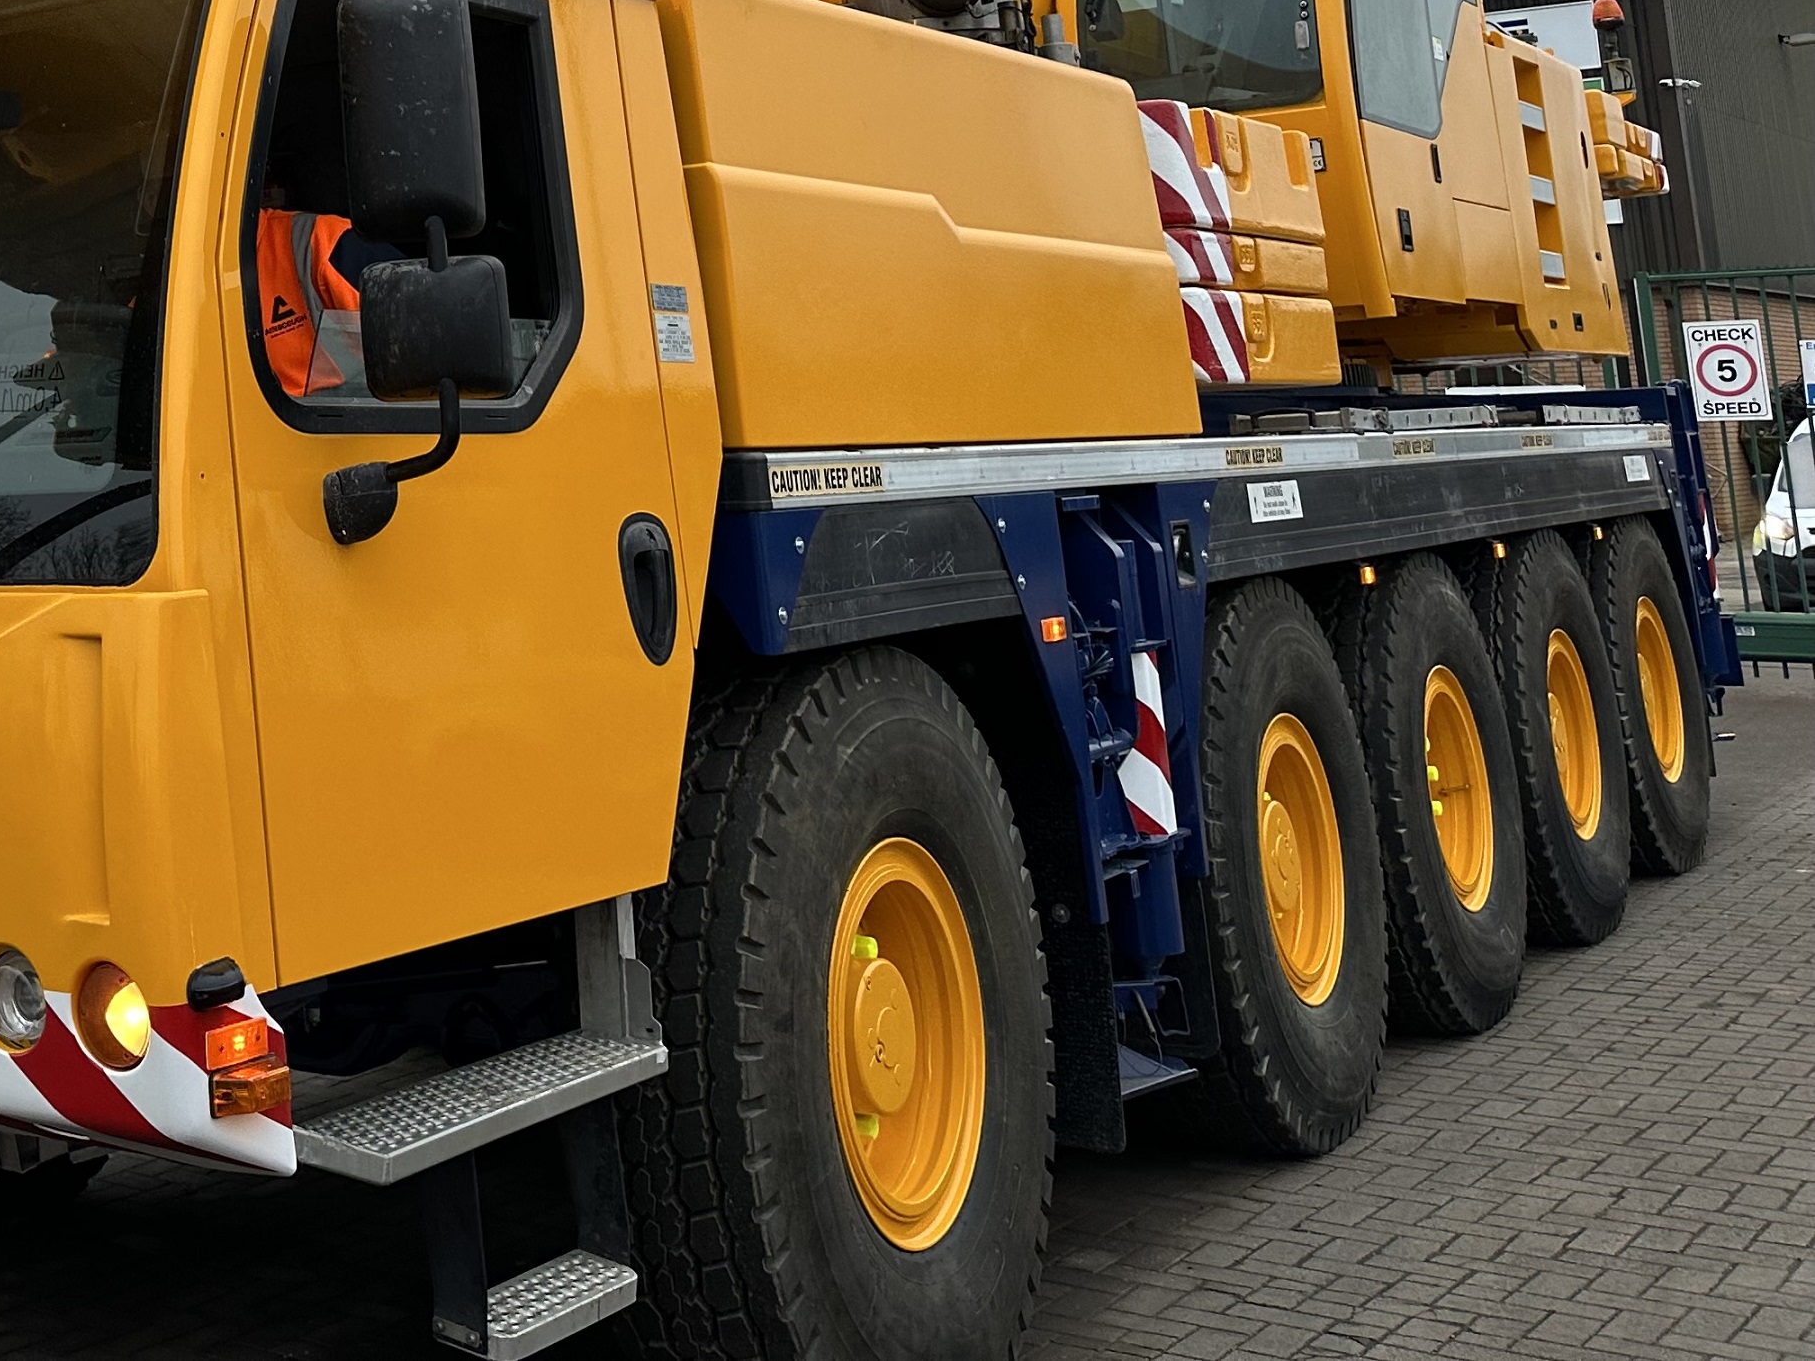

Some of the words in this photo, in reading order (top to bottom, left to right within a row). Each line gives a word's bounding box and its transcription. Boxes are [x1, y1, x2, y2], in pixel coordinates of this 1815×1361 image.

[1691, 327, 1754, 342] CHECK
[1717, 359, 1738, 383] 5
[1703, 401, 1762, 415] SPEED
[1252, 448, 1265, 463] KEEP
[1266, 447, 1283, 463] CLEAR
[771, 468, 822, 493] CAUTION!
[823, 467, 848, 489] KEEP
[851, 465, 883, 488] CLEAR
